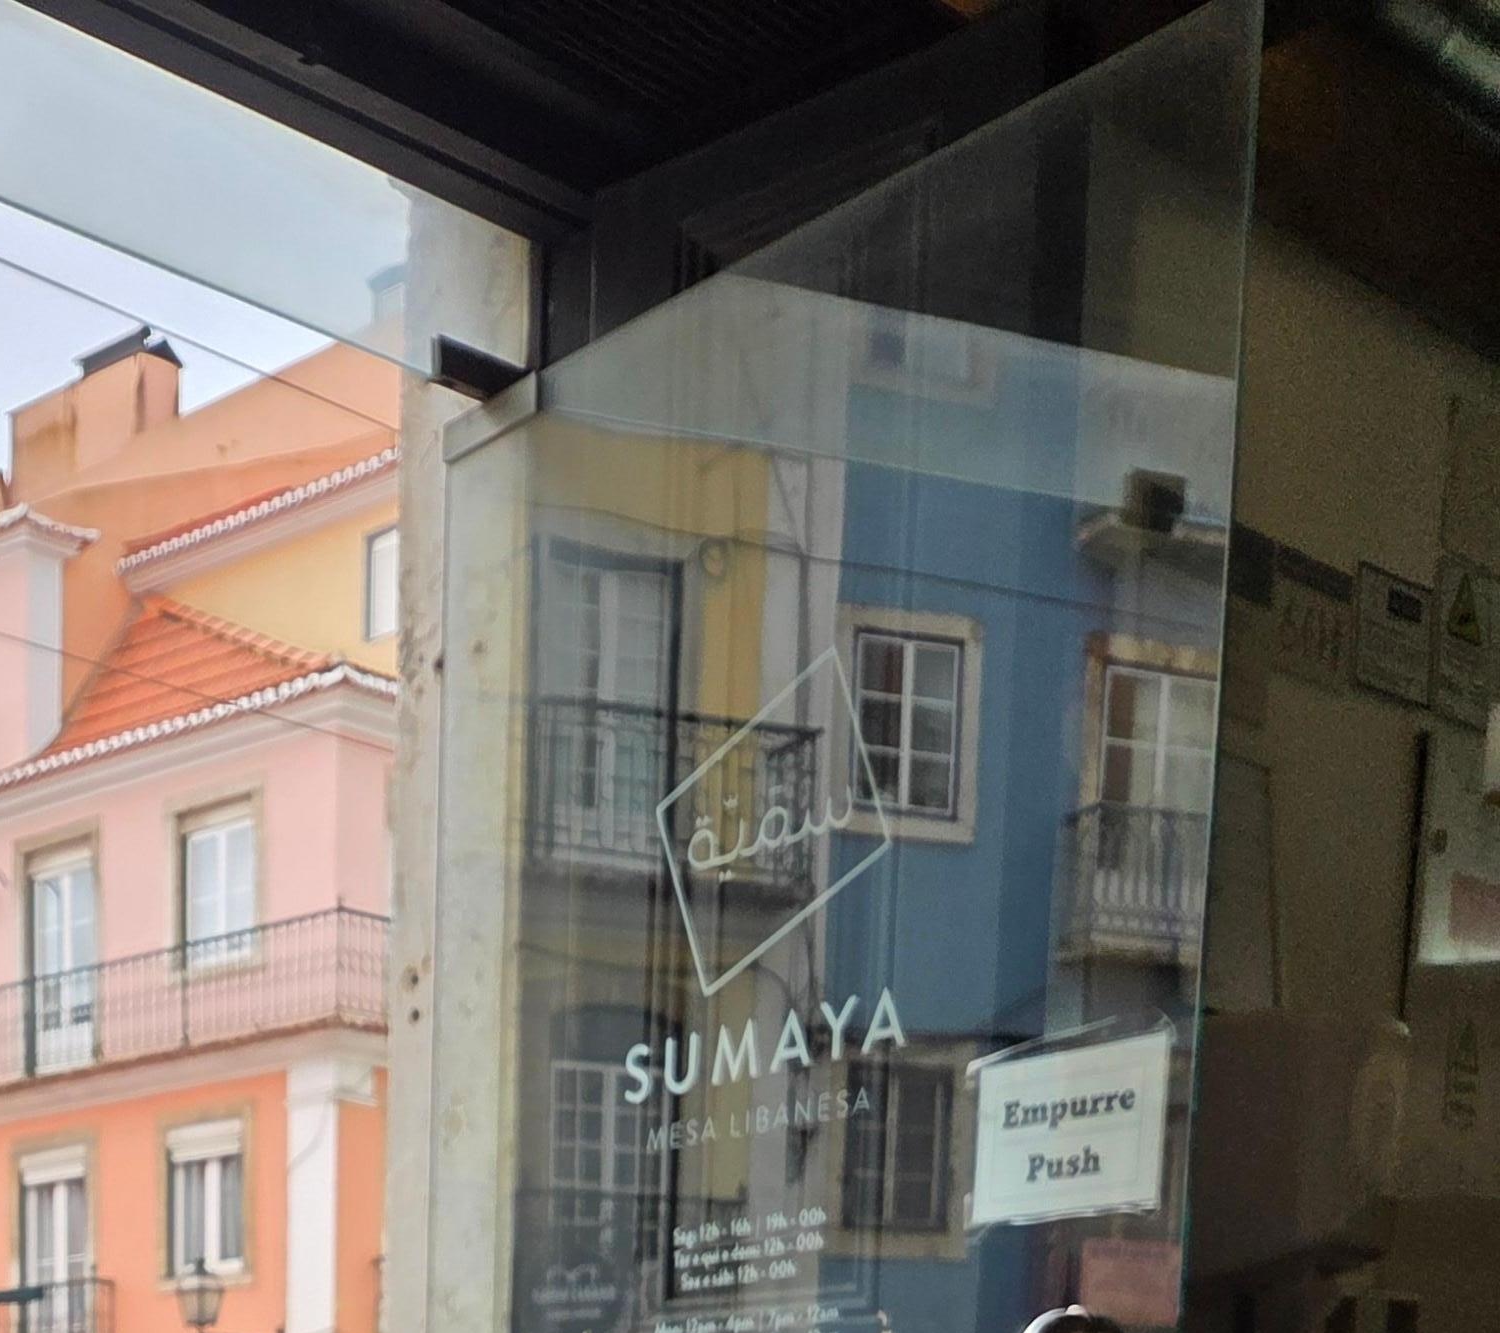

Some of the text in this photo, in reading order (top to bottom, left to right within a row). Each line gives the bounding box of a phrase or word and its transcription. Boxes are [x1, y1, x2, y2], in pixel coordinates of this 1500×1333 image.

[624, 986, 906, 1104] SUMAYA
[646, 1086, 870, 1153] MESA LIBANESA
[1002, 1087, 1135, 1129] Empurre
[1026, 1144, 1101, 1182] Push
[700, 1222, 719, 1243] 12h
[799, 1207, 826, 1226] 00h
[764, 1237, 785, 1255] 12h
[796, 1232, 824, 1251] 00h
[738, 1264, 758, 1283] 12h
[769, 1261, 796, 1280] 00h
